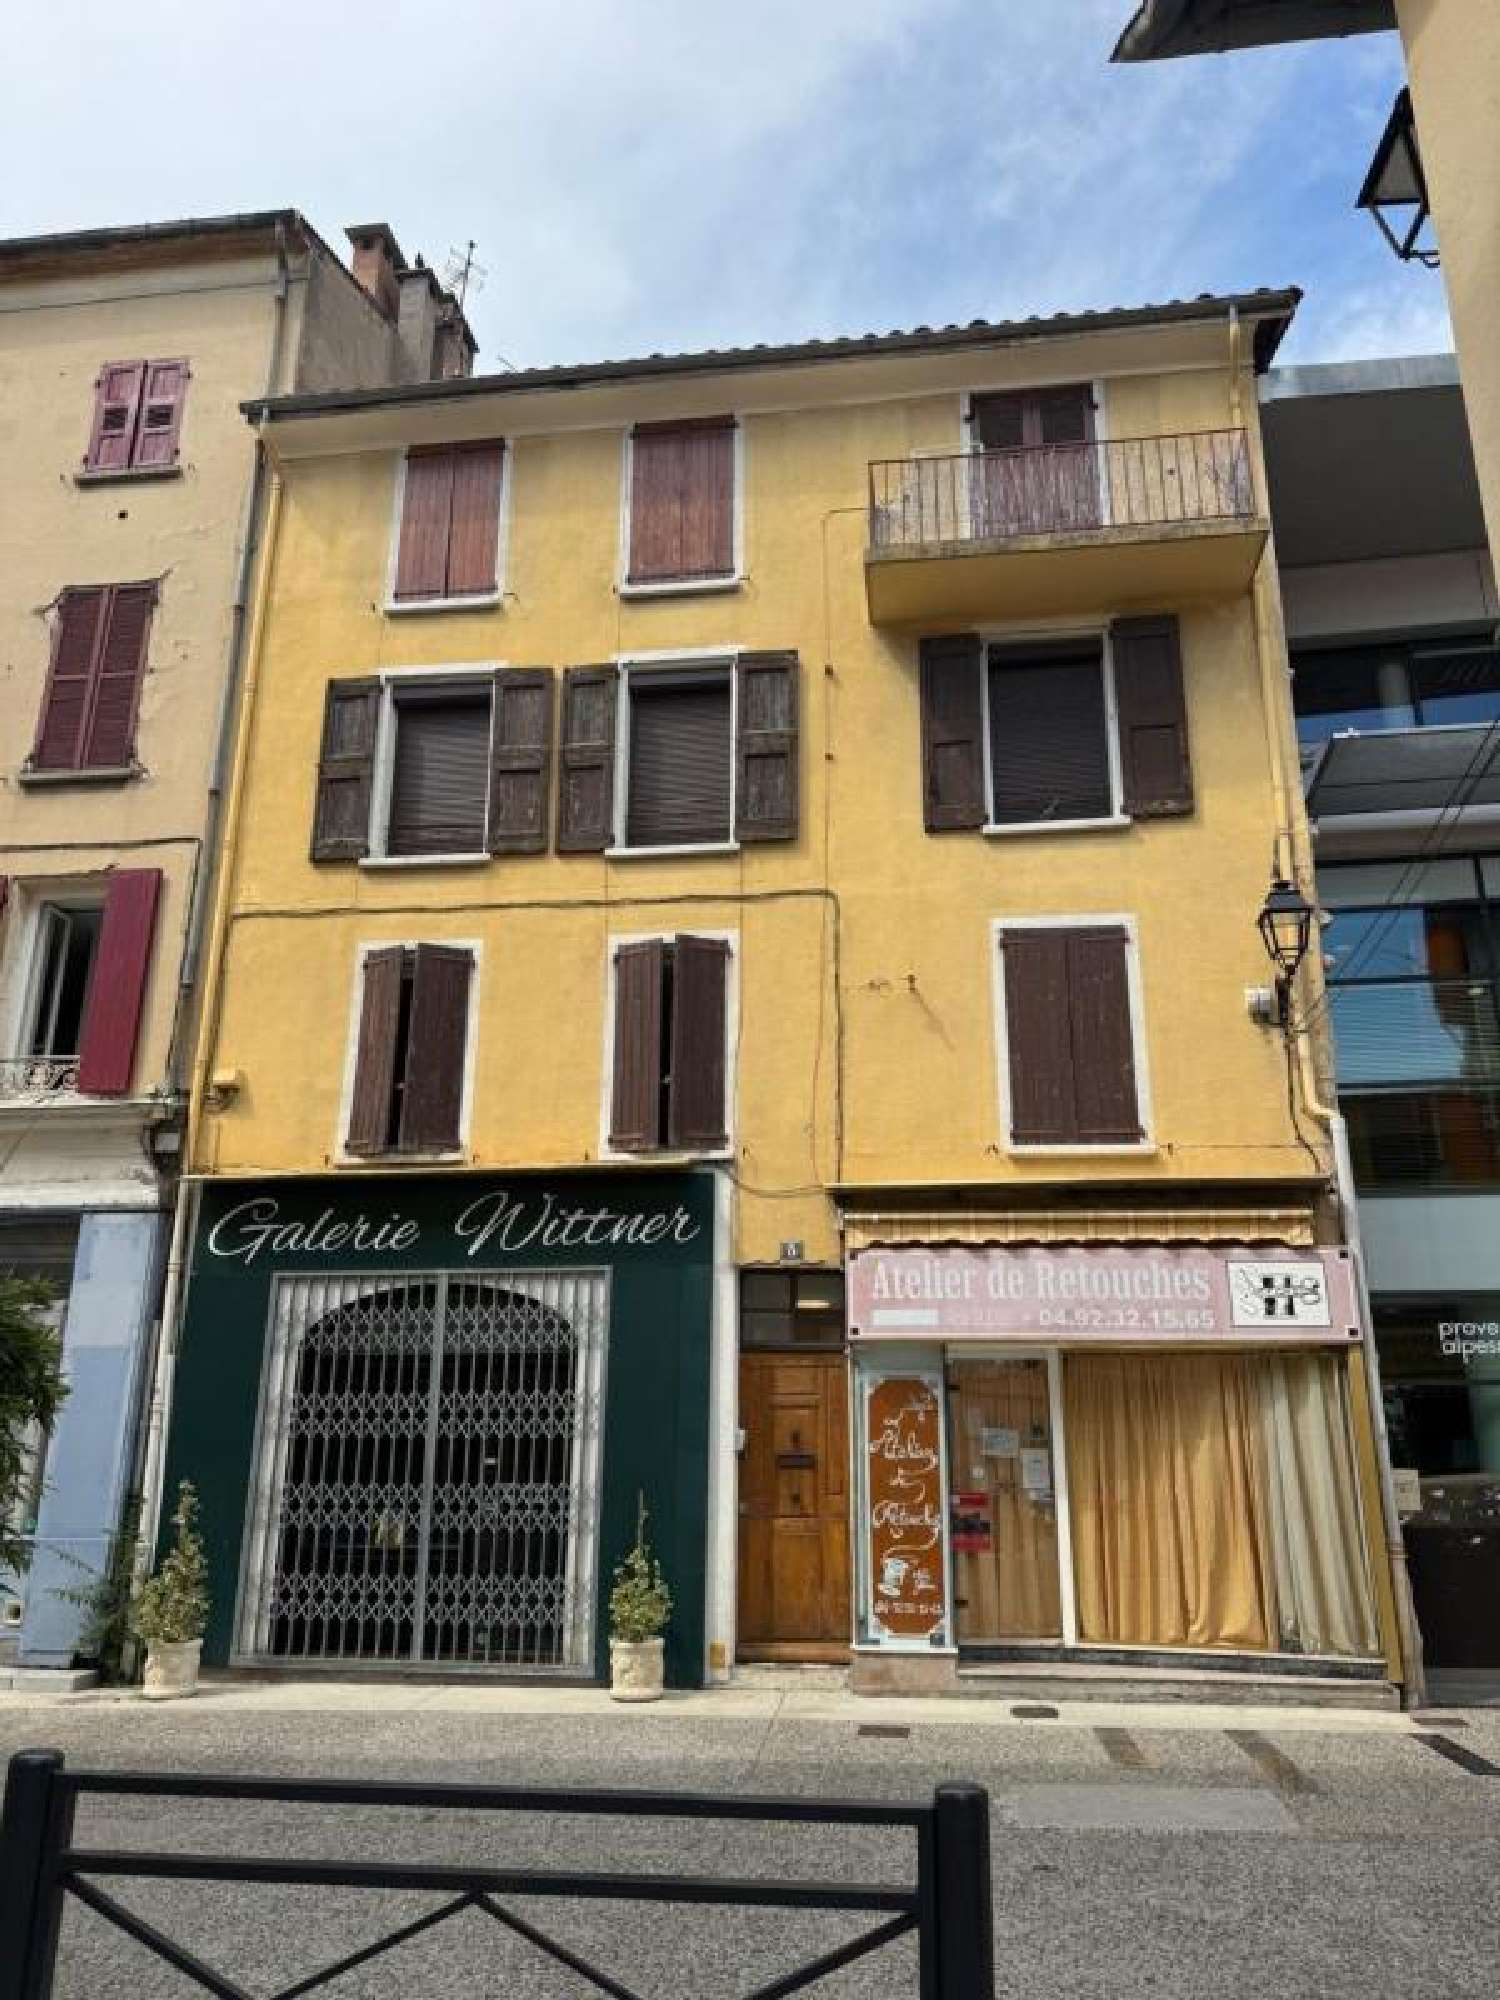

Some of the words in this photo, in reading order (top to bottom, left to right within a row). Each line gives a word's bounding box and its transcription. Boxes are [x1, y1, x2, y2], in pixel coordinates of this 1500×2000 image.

[207, 1197, 421, 1264] Galerie
[453, 1190, 701, 1256] Wittner
[872, 1260, 979, 1300] Atelier
[987, 1261, 1025, 1299] de
[1037, 1261, 1212, 1300] Retouches
